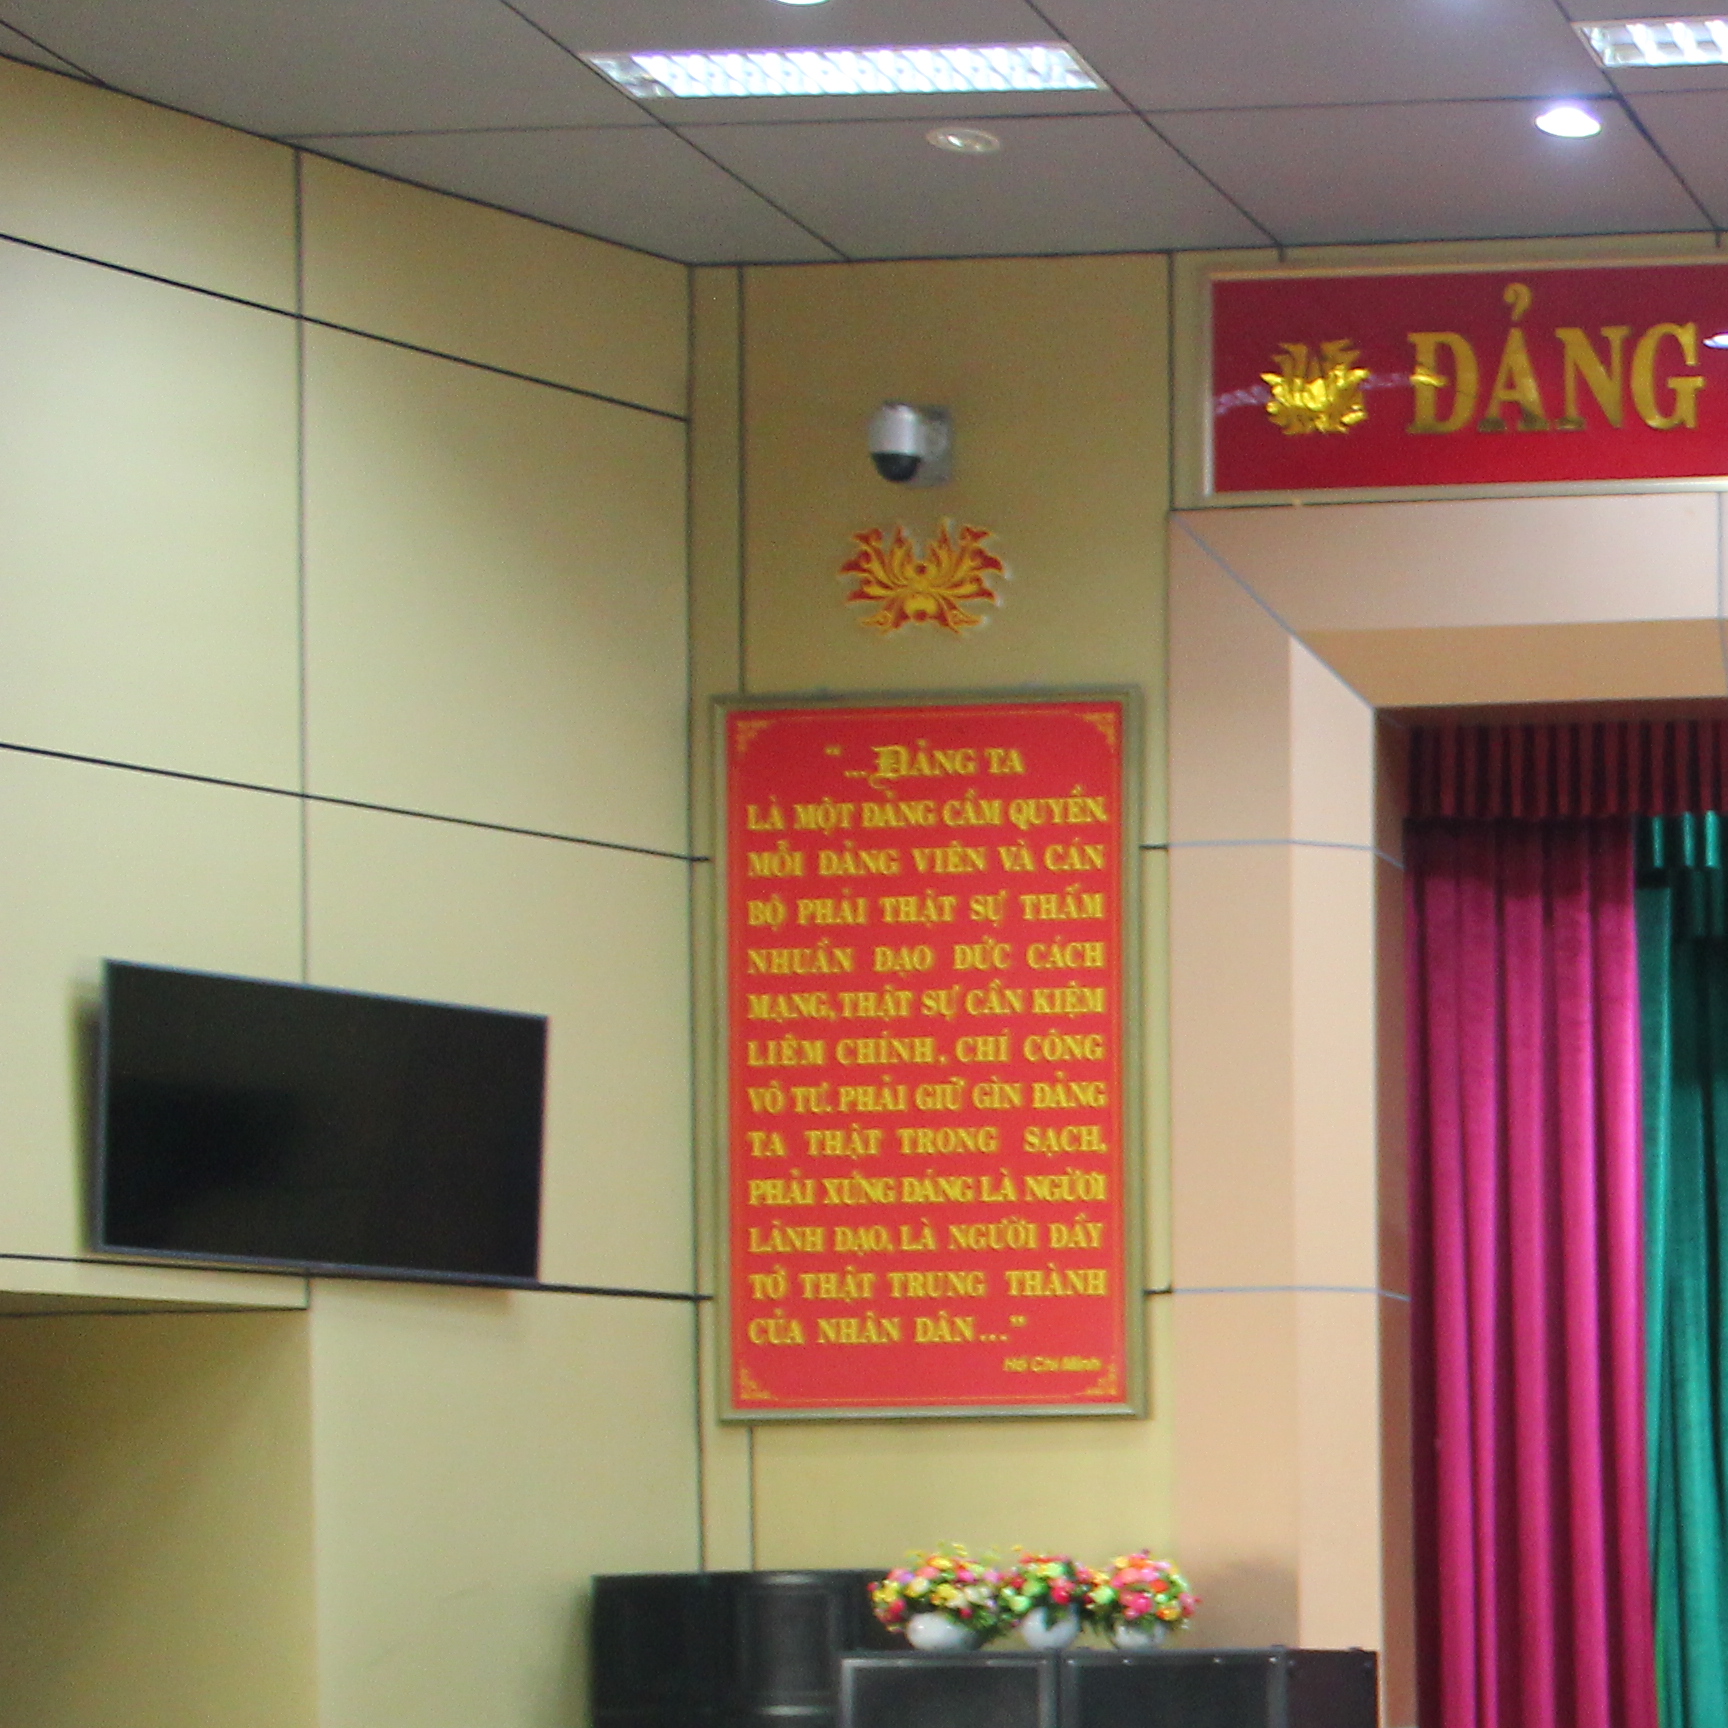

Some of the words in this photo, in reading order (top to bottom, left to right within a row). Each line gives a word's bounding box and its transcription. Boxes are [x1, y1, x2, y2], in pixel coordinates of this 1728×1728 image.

[1405, 285, 1700, 435] ĐẢNG
[985, 748, 1025, 774] TA
[748, 796, 785, 831] LÀ
[795, 797, 856, 834] MỘT
[862, 785, 937, 828] ĐẢNG
[942, 790, 1004, 827] CẦM
[819, 841, 900, 876] ĐẢNG
[912, 841, 987, 874] VIÊN
[998, 841, 1036, 872] VÀ
[1044, 838, 1105, 871] CÁN
[748, 896, 787, 929] BỘ
[798, 890, 868, 925] PHẢI
[880, 890, 958, 925] THẬT
[970, 890, 1008, 925] SỰ
[1020, 884, 1105, 920] THẤM
[748, 939, 854, 975] NHUẦN
[874, 945, 935, 976] ĐẠO
[954, 937, 1012, 971] ĐỨC
[1026, 937, 1106, 969] CÁCH
[838, 985, 915, 1020] THẬT
[921, 985, 961, 1020] SỰ
[965, 980, 1025, 1016] CẦN
[1032, 981, 1106, 1017] KIỆM
[748, 1034, 826, 1067] LIÊM
[955, 1030, 1011, 1063] CHÍ
[1023, 1029, 1107, 1062] CÔNG
[748, 1081, 787, 1114] VÔ
[838, 1075, 909, 1113] PHẢI
[915, 1076, 968, 1111] GIỮ
[971, 1077, 1024, 1110] GÌN
[1032, 1071, 1109, 1109] ĐẢNG
[747, 1130, 787, 1158] TA
[805, 1124, 884, 1158] THẬT
[897, 1126, 1000, 1155] TRONG
[749, 1169, 817, 1206] PHẢI
[822, 1172, 898, 1205] XỨNG
[899, 1170, 976, 1204] ĐÁNG
[979, 1168, 1019, 1203] LÀ
[1024, 1168, 1108, 1202] NGƯỜI
[750, 1220, 826, 1254] LÃNH
[900, 1219, 938, 1251] LÀ
[949, 1217, 1039, 1250] NGƯỜI
[1049, 1214, 1105, 1249] ĐẦY
[749, 1265, 789, 1300] TỚ
[800, 1266, 877, 1302] THẬT
[887, 1271, 987, 1298] TRUNG
[1005, 1263, 1109, 1297] THÀNH
[748, 1309, 806, 1345] CỦA
[818, 1311, 902, 1345] NHÂN
